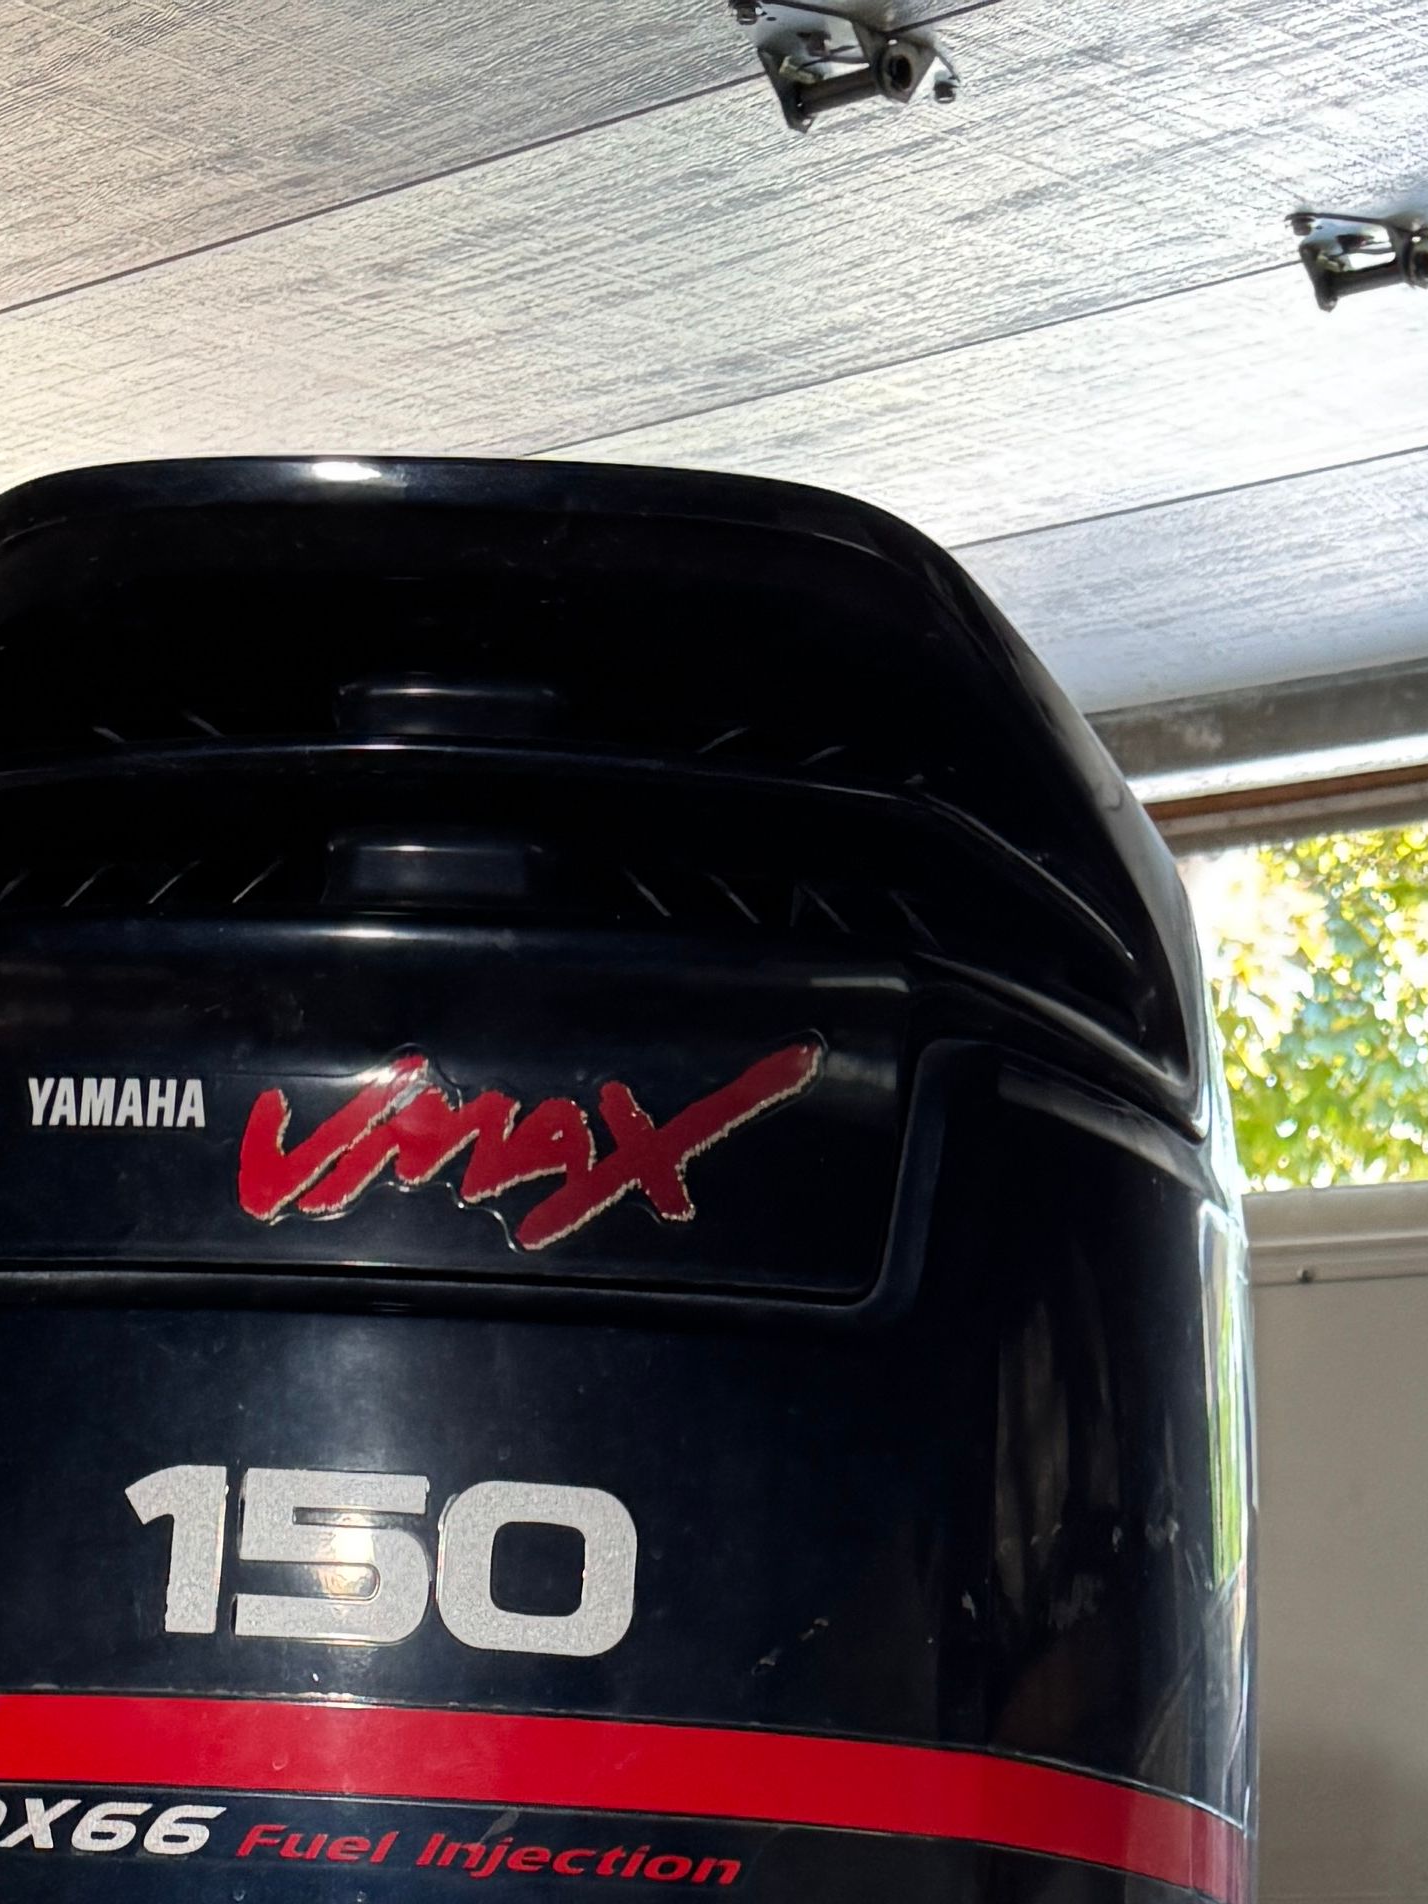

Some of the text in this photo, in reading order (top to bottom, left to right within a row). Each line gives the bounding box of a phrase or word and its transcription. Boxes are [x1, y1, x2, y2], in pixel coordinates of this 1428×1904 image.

[27, 1077, 206, 1130] YAMAHA
[124, 1462, 639, 1656] 150
[236, 1821, 393, 1864] Fuel
[417, 1830, 743, 1887] Injection
